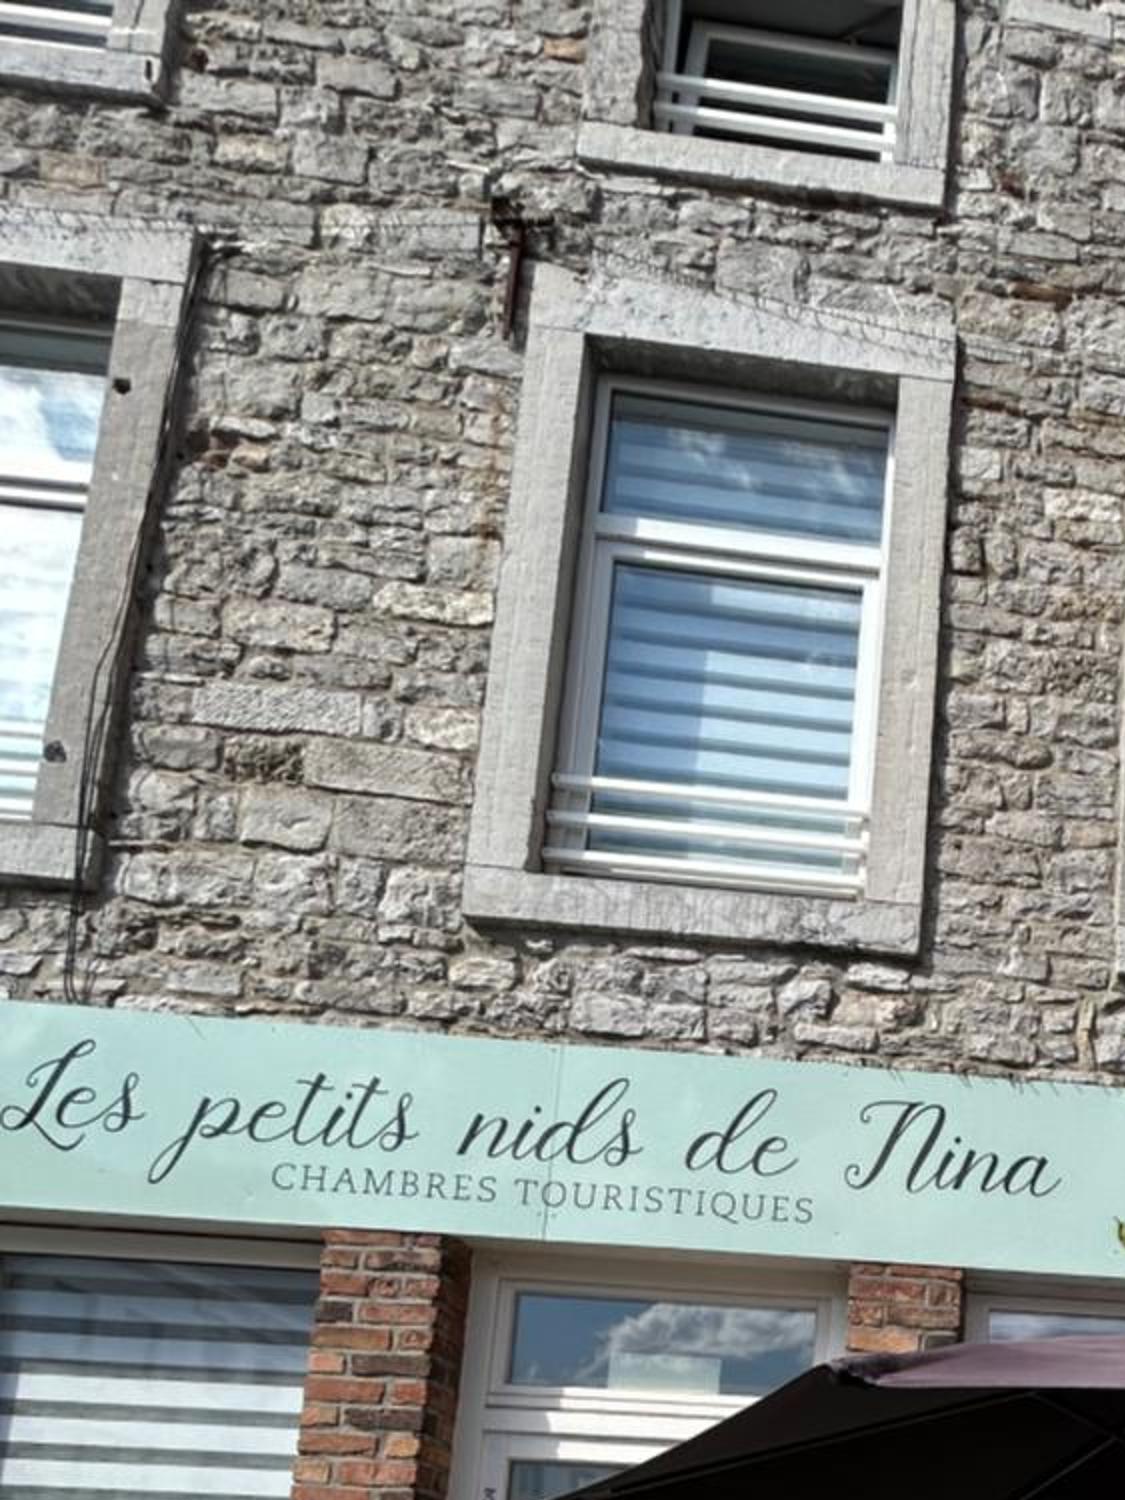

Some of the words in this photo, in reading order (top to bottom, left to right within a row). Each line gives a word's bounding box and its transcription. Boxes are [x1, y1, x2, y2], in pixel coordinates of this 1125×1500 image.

[0, 1038, 147, 1151] Les
[148, 1072, 420, 1184] petits
[456, 1077, 643, 1166] nids
[685, 1087, 799, 1177] de
[843, 1100, 1063, 1198] Nina
[271, 1162, 498, 1203] CHAMBRES
[514, 1177, 814, 1224] TOURISTIQUES
